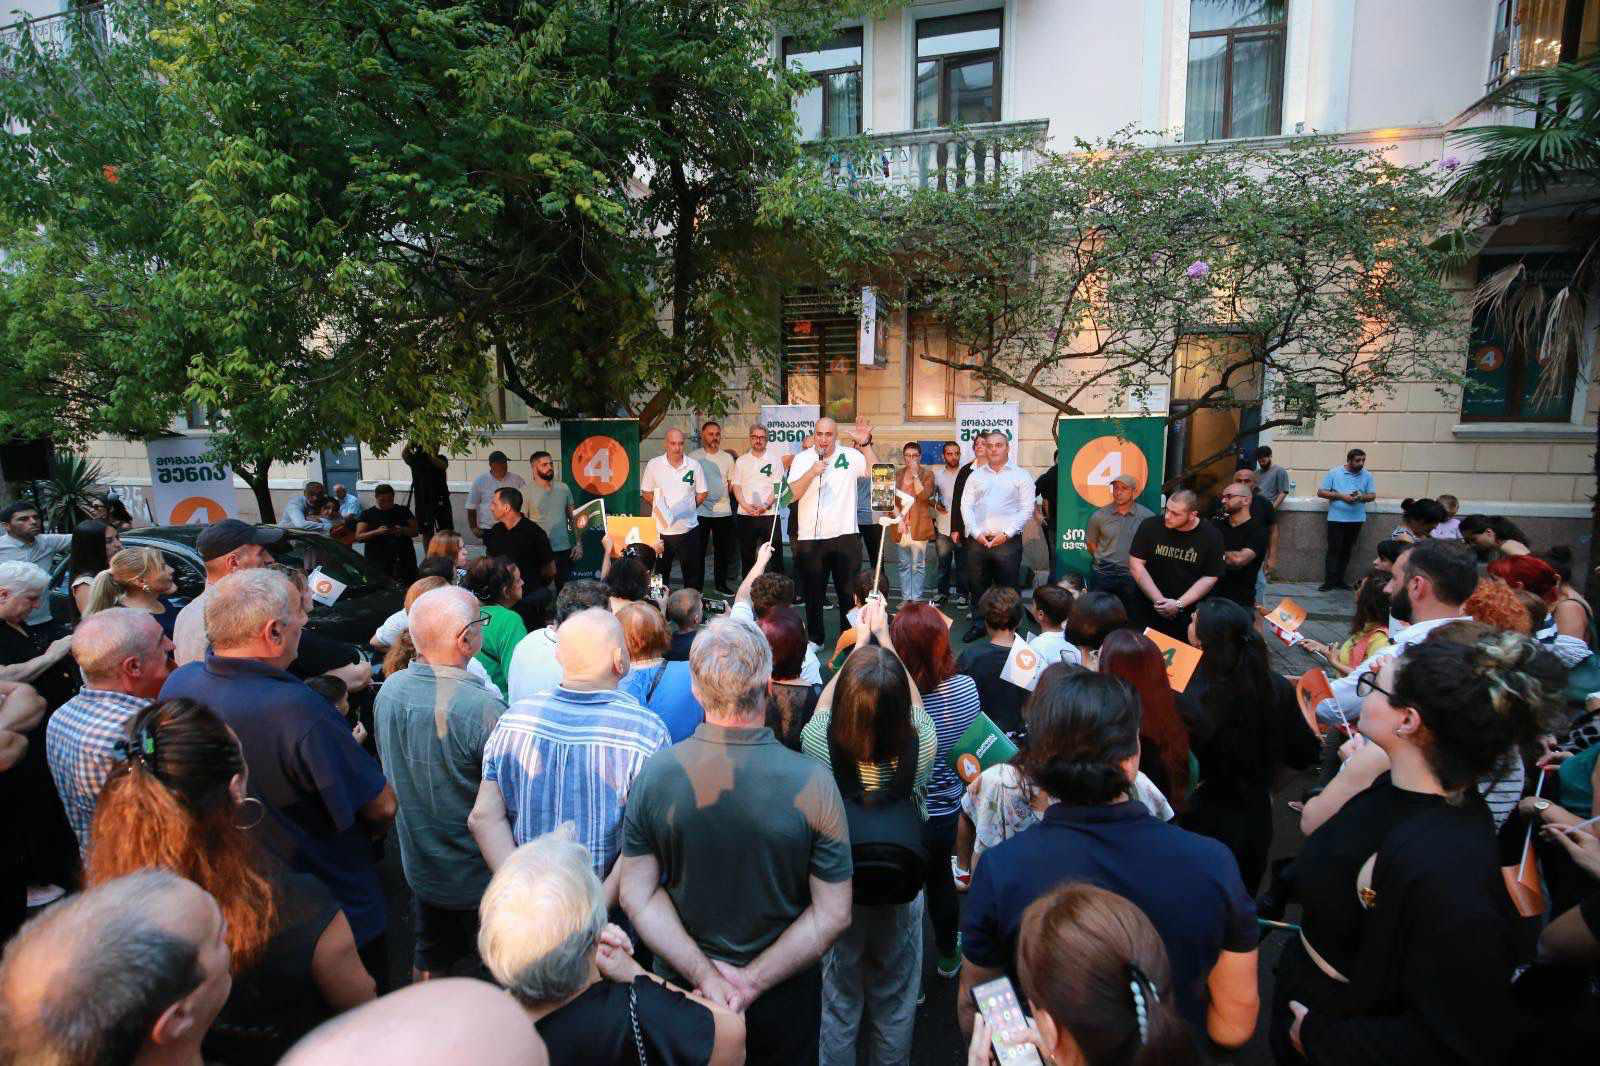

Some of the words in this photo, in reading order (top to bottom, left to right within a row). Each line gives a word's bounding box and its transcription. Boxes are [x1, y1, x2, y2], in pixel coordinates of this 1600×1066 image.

[584, 448, 612, 483] 4
[759, 463, 773, 477] 4
[833, 452, 850, 470] 4
[682, 470, 695, 486] 4
[1087, 451, 1122, 496] 4
